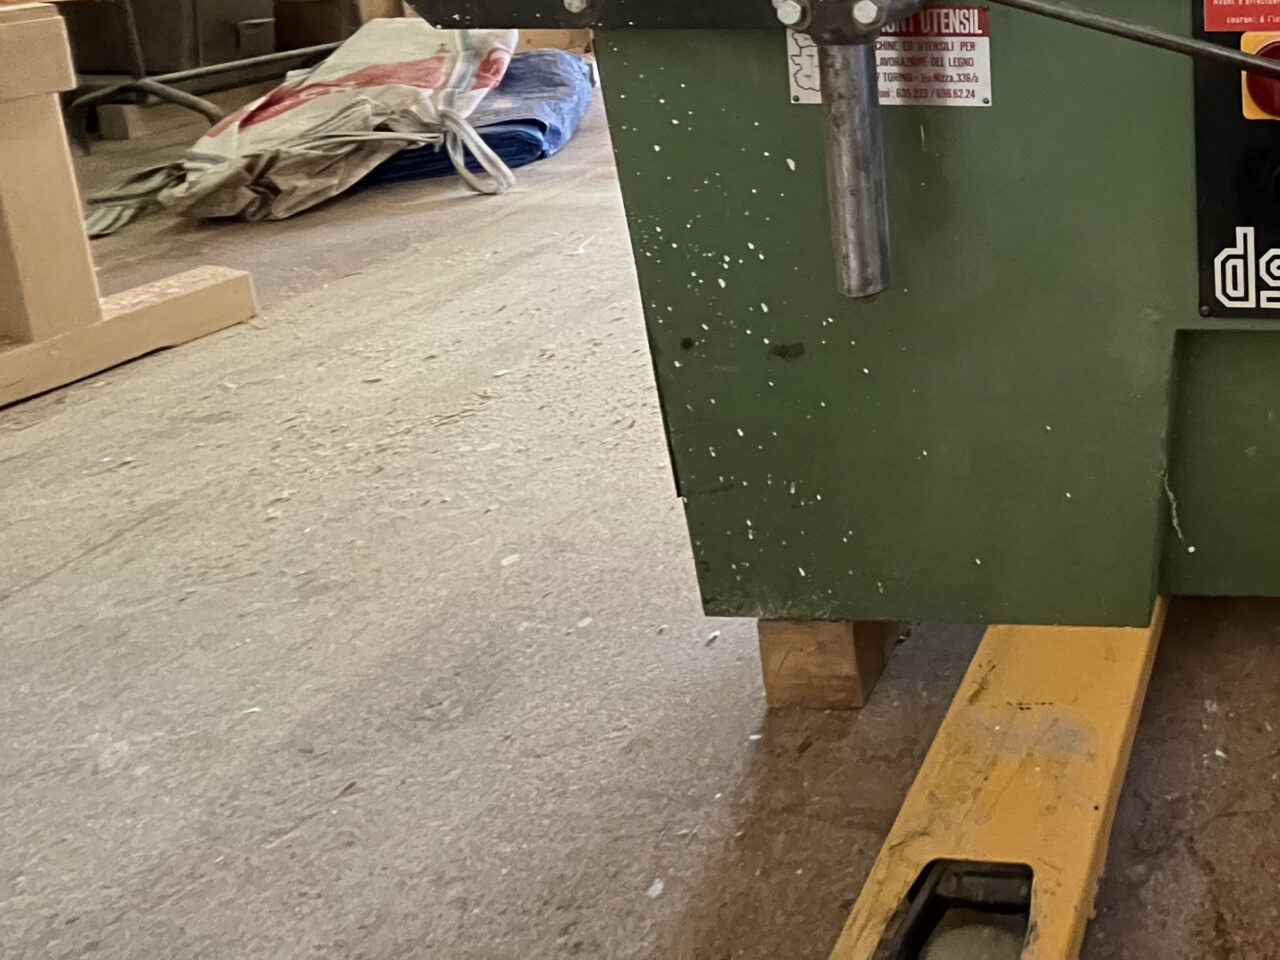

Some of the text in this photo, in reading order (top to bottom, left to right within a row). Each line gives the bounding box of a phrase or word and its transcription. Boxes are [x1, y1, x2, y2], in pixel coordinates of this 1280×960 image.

[920, 8, 983, 35] UTENSIL
[918, 41, 955, 52] UTENSILI
[959, 41, 977, 52] PER
[930, 57, 944, 68] DEL
[948, 57, 975, 68] LEGNO
[883, 72, 913, 83] TORINO
